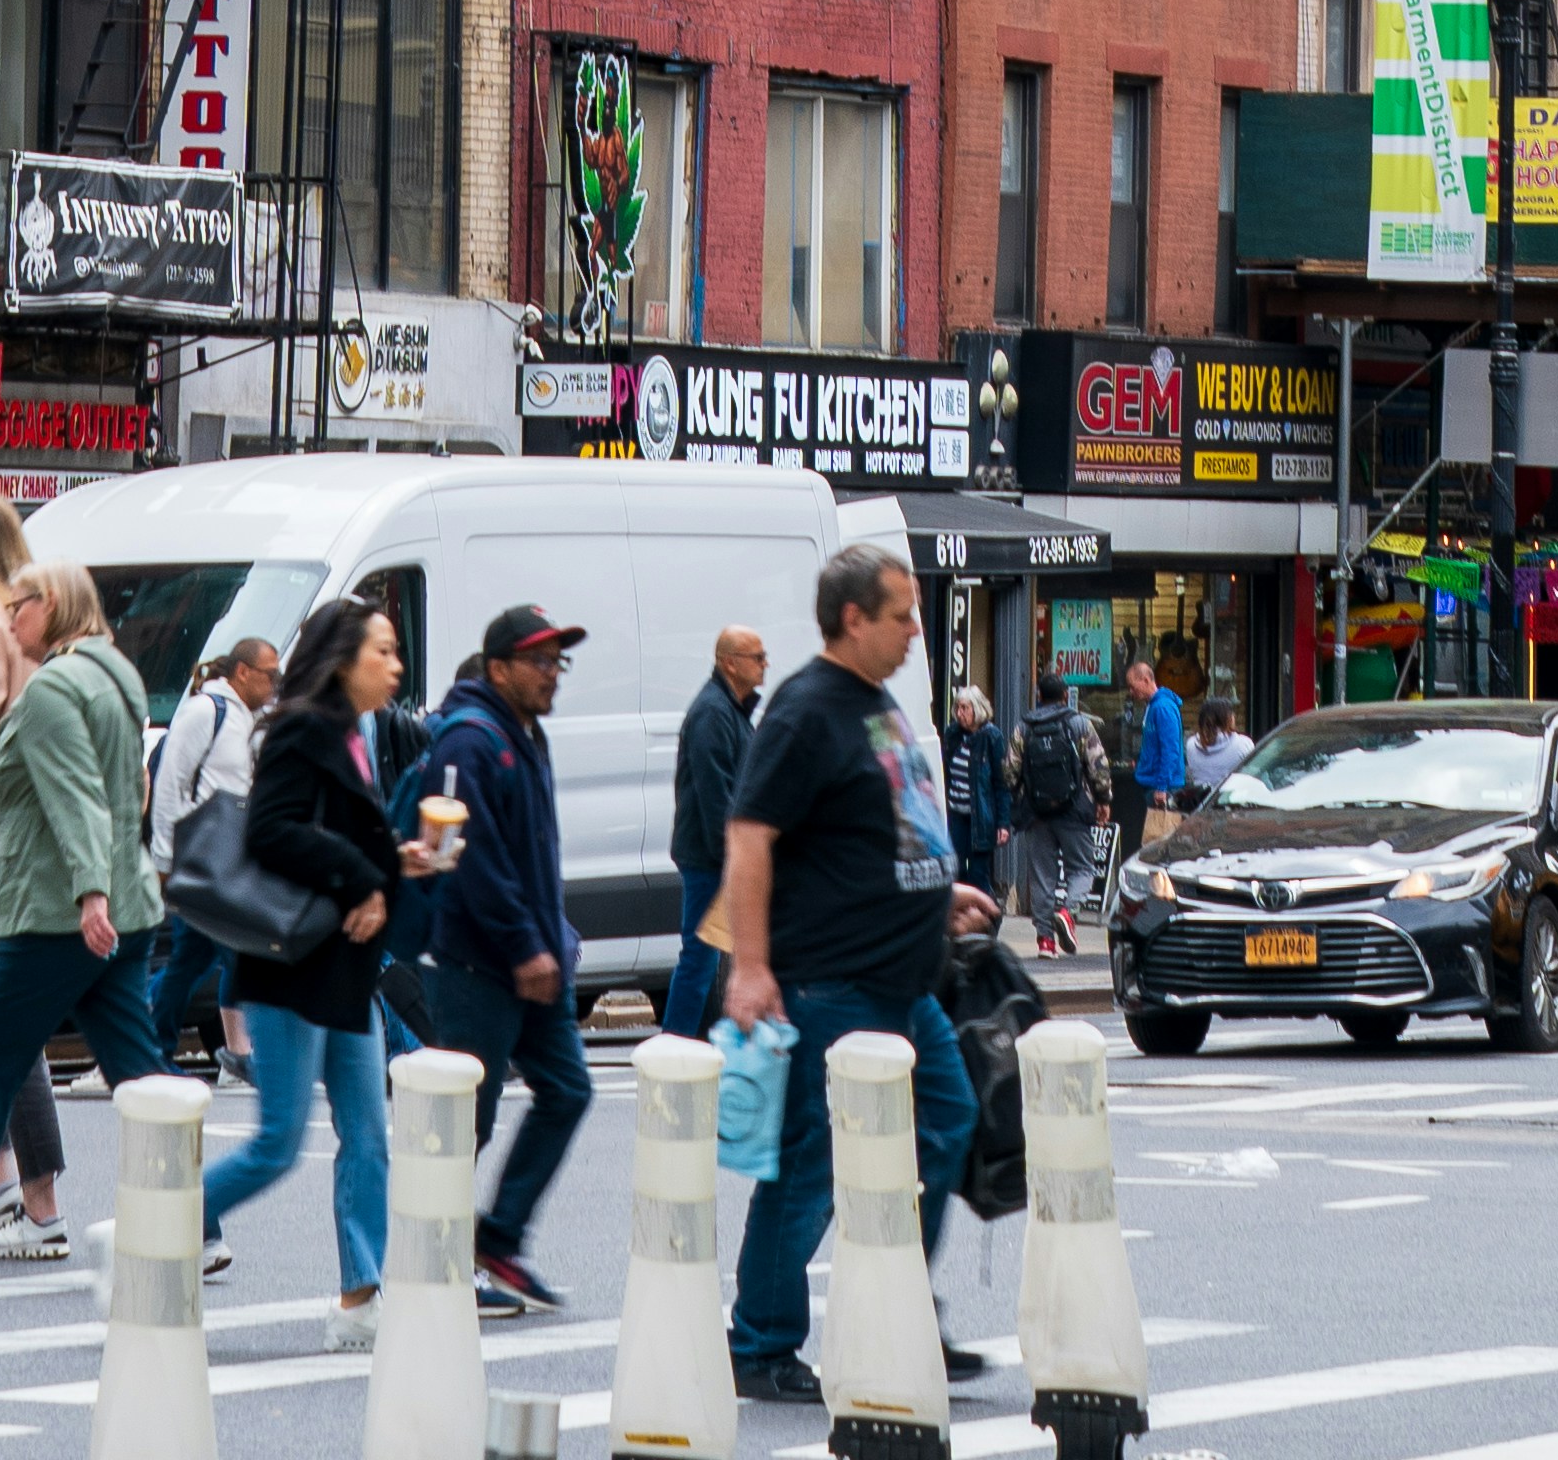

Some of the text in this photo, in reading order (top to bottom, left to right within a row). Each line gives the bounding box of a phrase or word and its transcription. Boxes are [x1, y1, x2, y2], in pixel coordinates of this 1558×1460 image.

[1077, 361, 1183, 437] GEM
[1196, 362, 1335, 415] WE BUY & LOAN
[686, 366, 763, 443] KUNG
[773, 371, 808, 441] FU
[817, 374, 926, 448] KITCHEN
[69, 403, 150, 452] OUTLET
[1195, 419, 1333, 444] GOLD DIAMONDS WATCHES
[773, 448, 803, 470] RAMEN
[815, 451, 832, 472] DIM
[833, 452, 852, 472] SUM
[865, 452, 883, 473] HOT
[884, 452, 900, 474] POT
[901, 453, 924, 475] SOUP
[1075, 442, 1182, 464] PAWNBROKERS
[1200, 456, 1251, 476] PRESTAMOS
[1075, 470, 1182, 486] WWW.GEMPAWNBROKERS.COM
[1275, 457, 1330, 477] 212-730-1124
[21, 475, 59, 500] CHANGE
[936, 534, 967, 568] 610
[1029, 535, 1098, 565] 212-951-1935
[1056, 649, 1101, 676] SAVINGS
